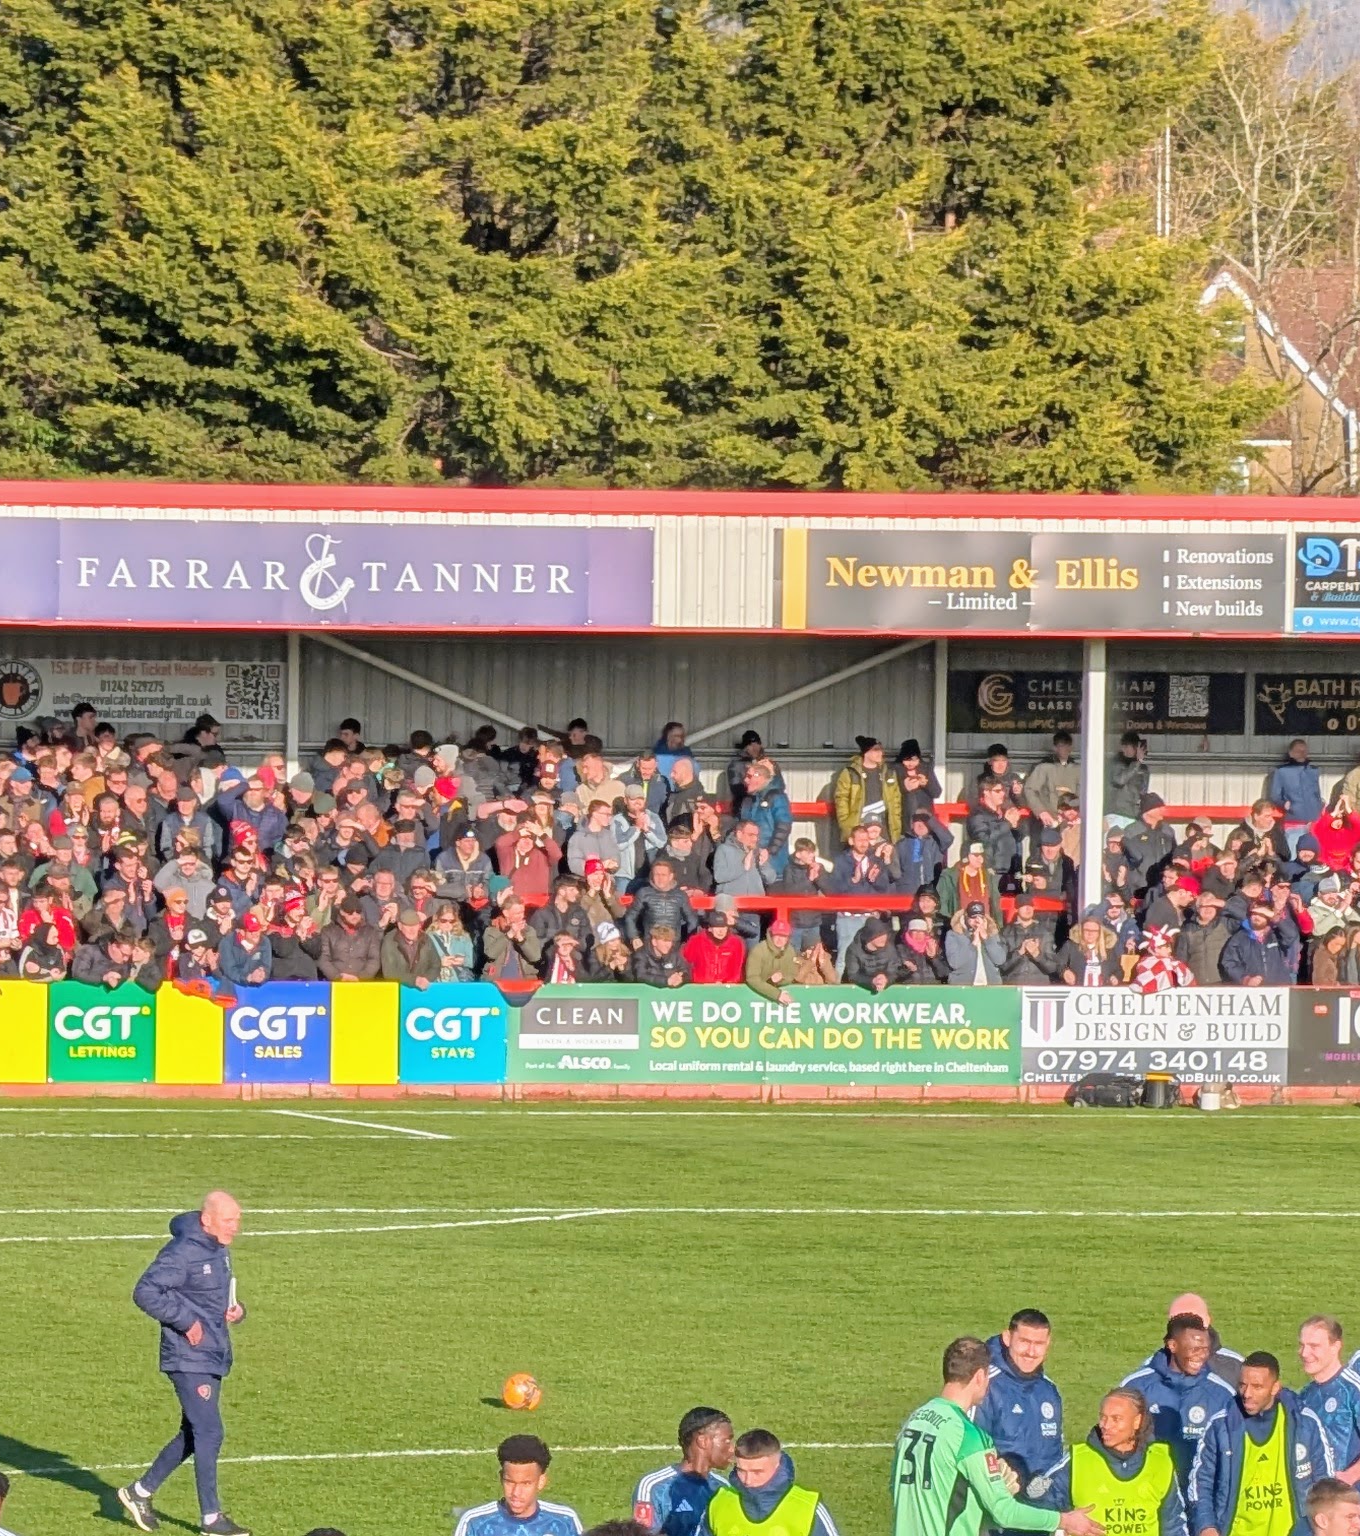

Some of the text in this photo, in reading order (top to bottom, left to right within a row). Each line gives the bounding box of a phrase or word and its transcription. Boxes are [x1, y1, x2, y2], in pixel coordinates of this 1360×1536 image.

[1176, 549, 1274, 565] Renovations
[77, 557, 575, 595] FARRAR TANNER
[825, 556, 1139, 591] Newman & Ellis
[1176, 575, 1263, 591] Extensions
[946, 592, 1018, 611] Limited
[1176, 601, 1264, 618] New builds
[1294, 679, 1346, 696] BATH
[650, 1000, 971, 1027] WE DO THE WORKWEAR,
[1074, 993, 1283, 1017] CHELTENHAM
[53, 1005, 142, 1040] CGT
[229, 1006, 318, 1041] CGT
[405, 1007, 492, 1041] CGT
[535, 1007, 624, 1025] CLEAN
[650, 1026, 1010, 1050] SO YOU CAN DO THE WORK
[1074, 1022, 1282, 1042] DESIGN & BUILD
[69, 1045, 137, 1058] LETTINGS
[254, 1045, 303, 1059] SALES
[430, 1046, 476, 1059] STAYS
[1037, 1050, 1268, 1071] 07974 340148
[649, 1060, 678, 1072] Local
[678, 1060, 721, 1072] uniform
[721, 1060, 754, 1073] rental
[755, 1061, 764, 1072] &
[765, 1060, 808, 1075] laundry
[849, 1060, 881, 1073] based
[881, 1060, 908, 1075] right
[908, 1060, 933, 1073] here
[934, 1060, 944, 1073] in
[945, 1060, 1009, 1073] Cheltenham
[899, 1427, 937, 1491] 31
[1105, 1507, 1147, 1522] KING
